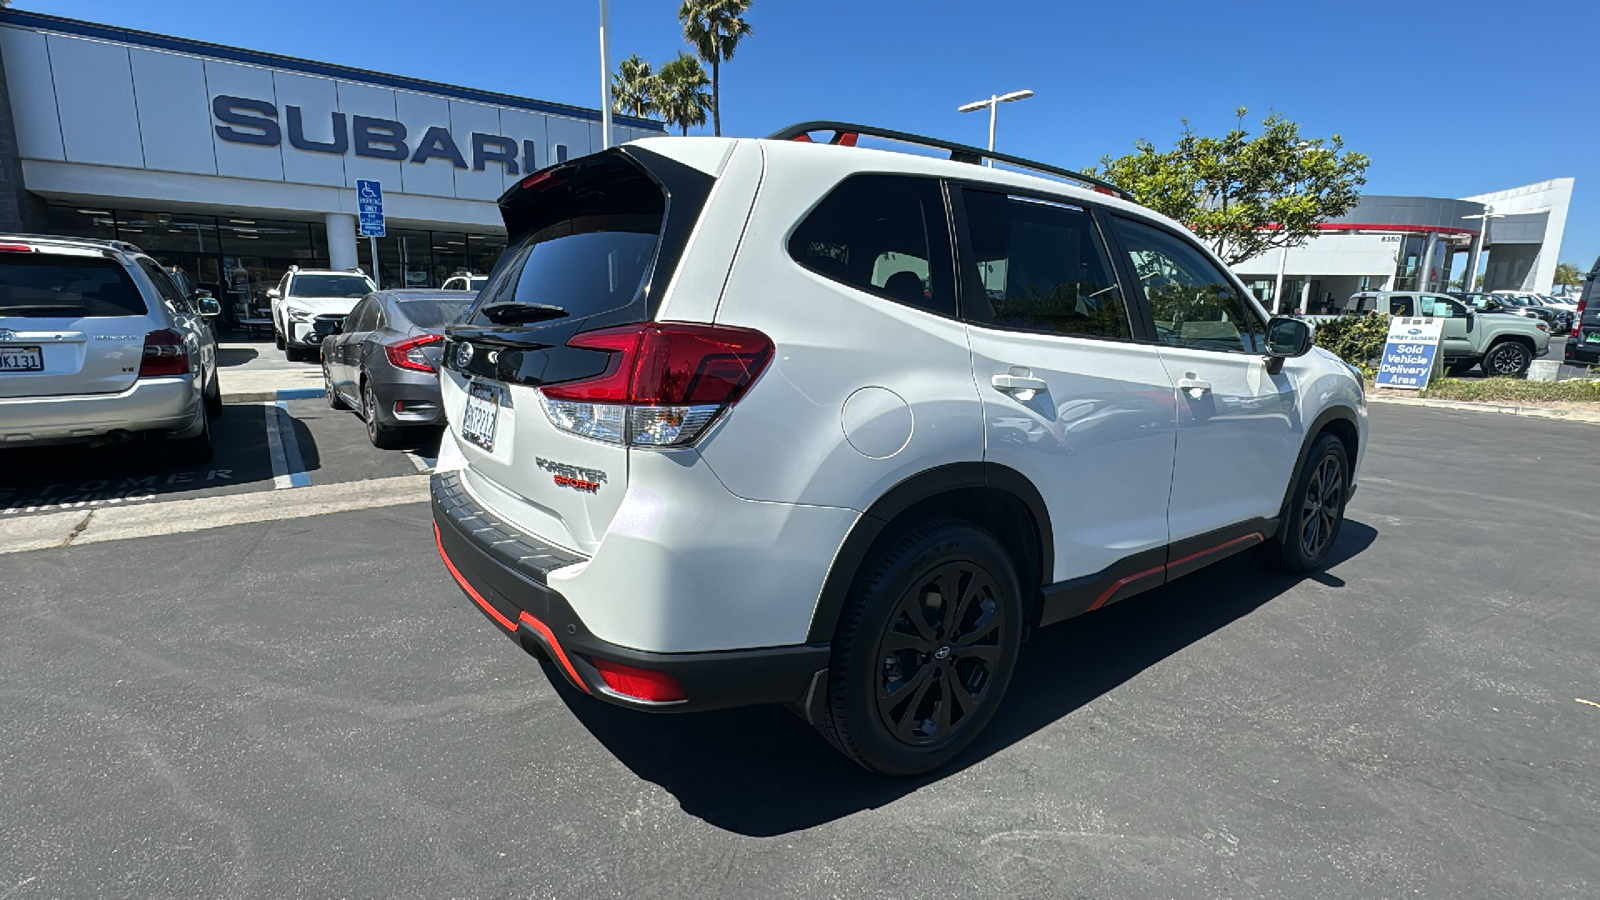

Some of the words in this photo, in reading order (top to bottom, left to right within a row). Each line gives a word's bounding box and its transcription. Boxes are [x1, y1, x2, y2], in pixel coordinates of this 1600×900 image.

[213, 94, 569, 176] SUBARU
[1396, 344, 1424, 354] Sold
[1387, 354, 1428, 365] Vehicle
[1381, 364, 1428, 377] Delivery
[1389, 374, 1417, 385] Area
[535, 456, 608, 484] FORESTER
[553, 474, 599, 492] SPORT
